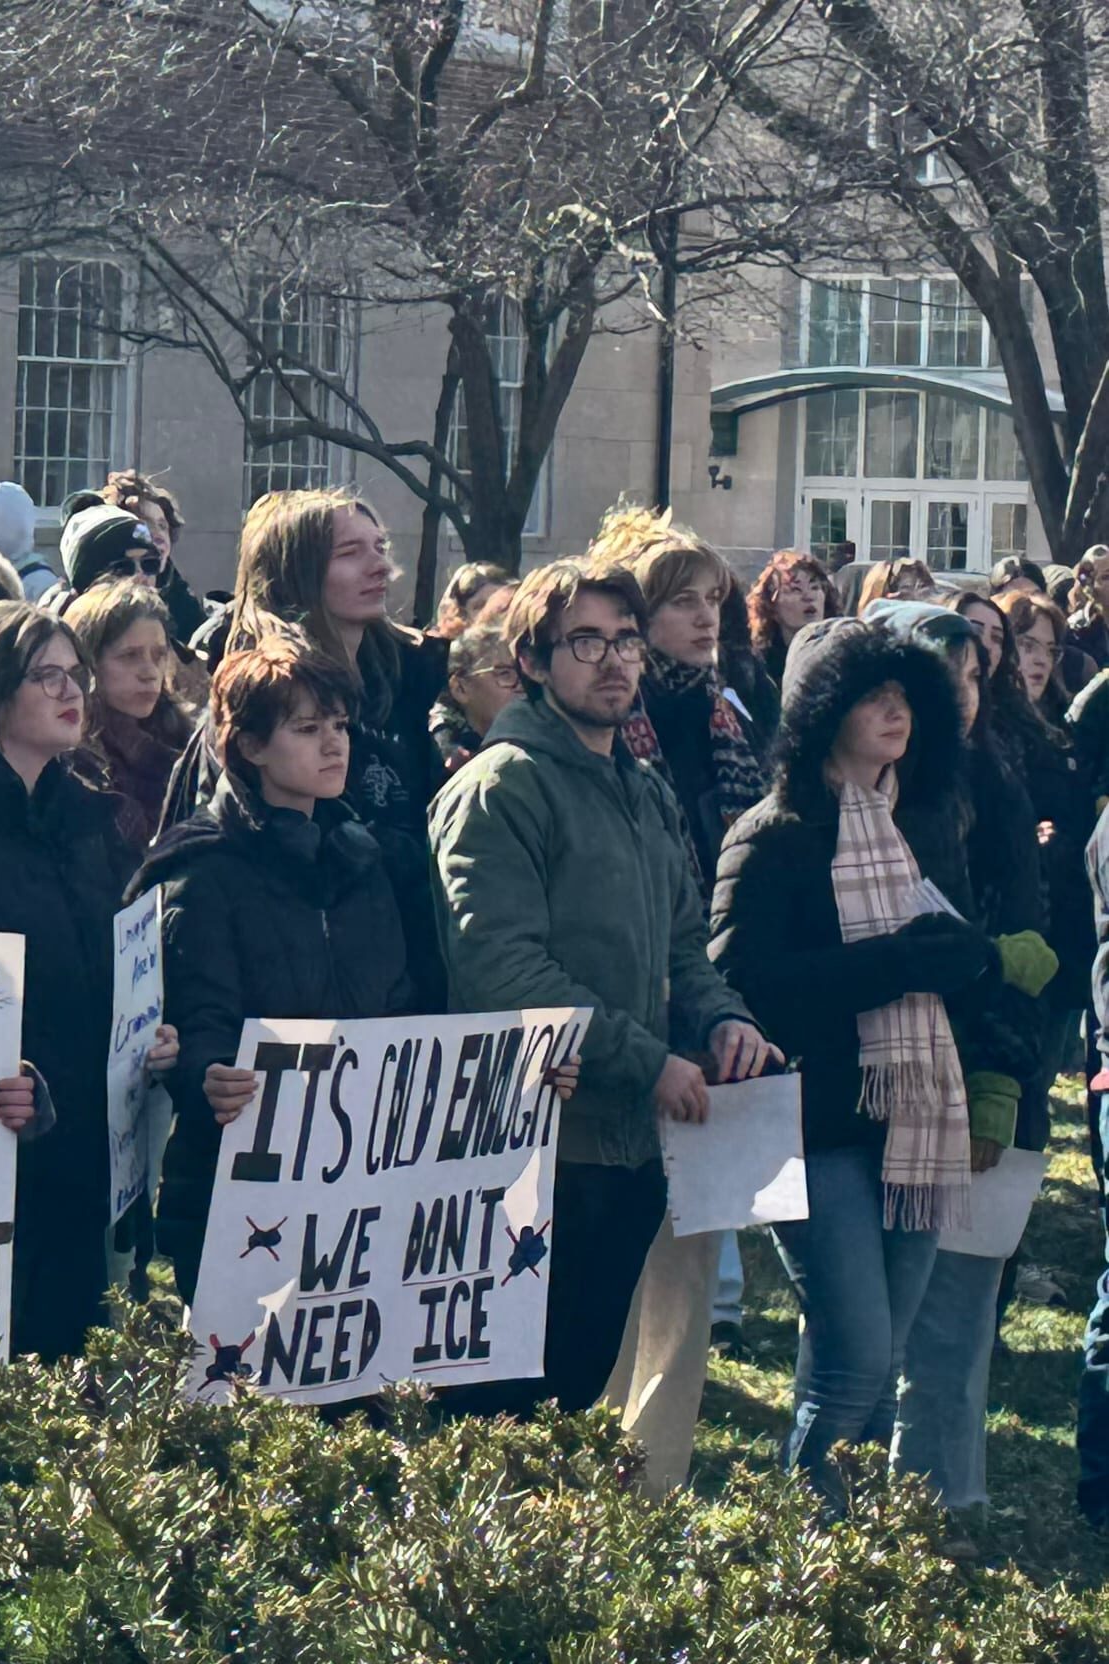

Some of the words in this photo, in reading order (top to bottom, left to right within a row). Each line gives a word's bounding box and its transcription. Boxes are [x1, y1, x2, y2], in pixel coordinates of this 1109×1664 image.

[231, 1036, 359, 1184] IT'S
[366, 1037, 443, 1175] COLD
[436, 1023, 580, 1163] ENOUGH
[298, 1205, 381, 1292] WE
[402, 1185, 506, 1282] DON'T
[259, 1297, 382, 1386] NEED
[413, 1275, 495, 1364] ICE
